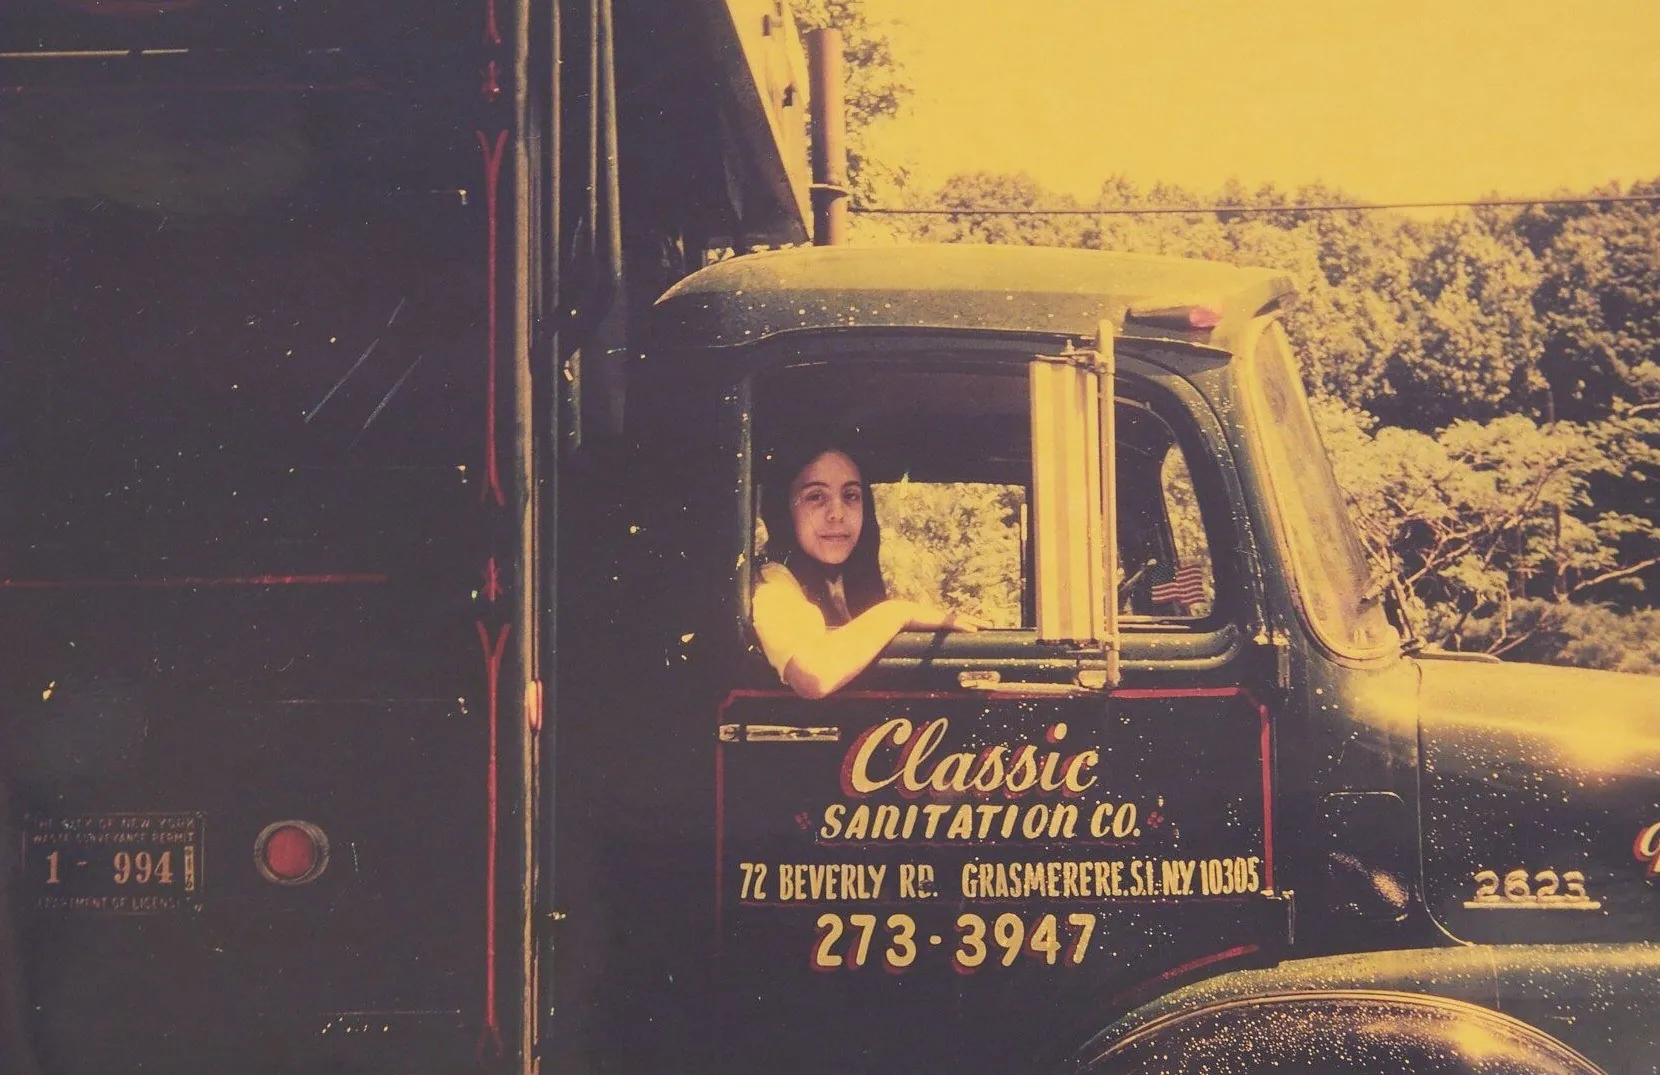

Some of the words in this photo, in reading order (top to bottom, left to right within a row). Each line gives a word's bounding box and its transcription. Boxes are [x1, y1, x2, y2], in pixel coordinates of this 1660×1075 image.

[850, 717, 1099, 794] Classic
[821, 803, 1077, 840] SANITATION
[1090, 803, 1142, 839] CO.
[47, 851, 60, 883] 1
[114, 851, 173, 884] 994
[740, 862, 767, 899] 72
[780, 864, 886, 900] BEVERLY
[1200, 856, 1260, 894] 10305
